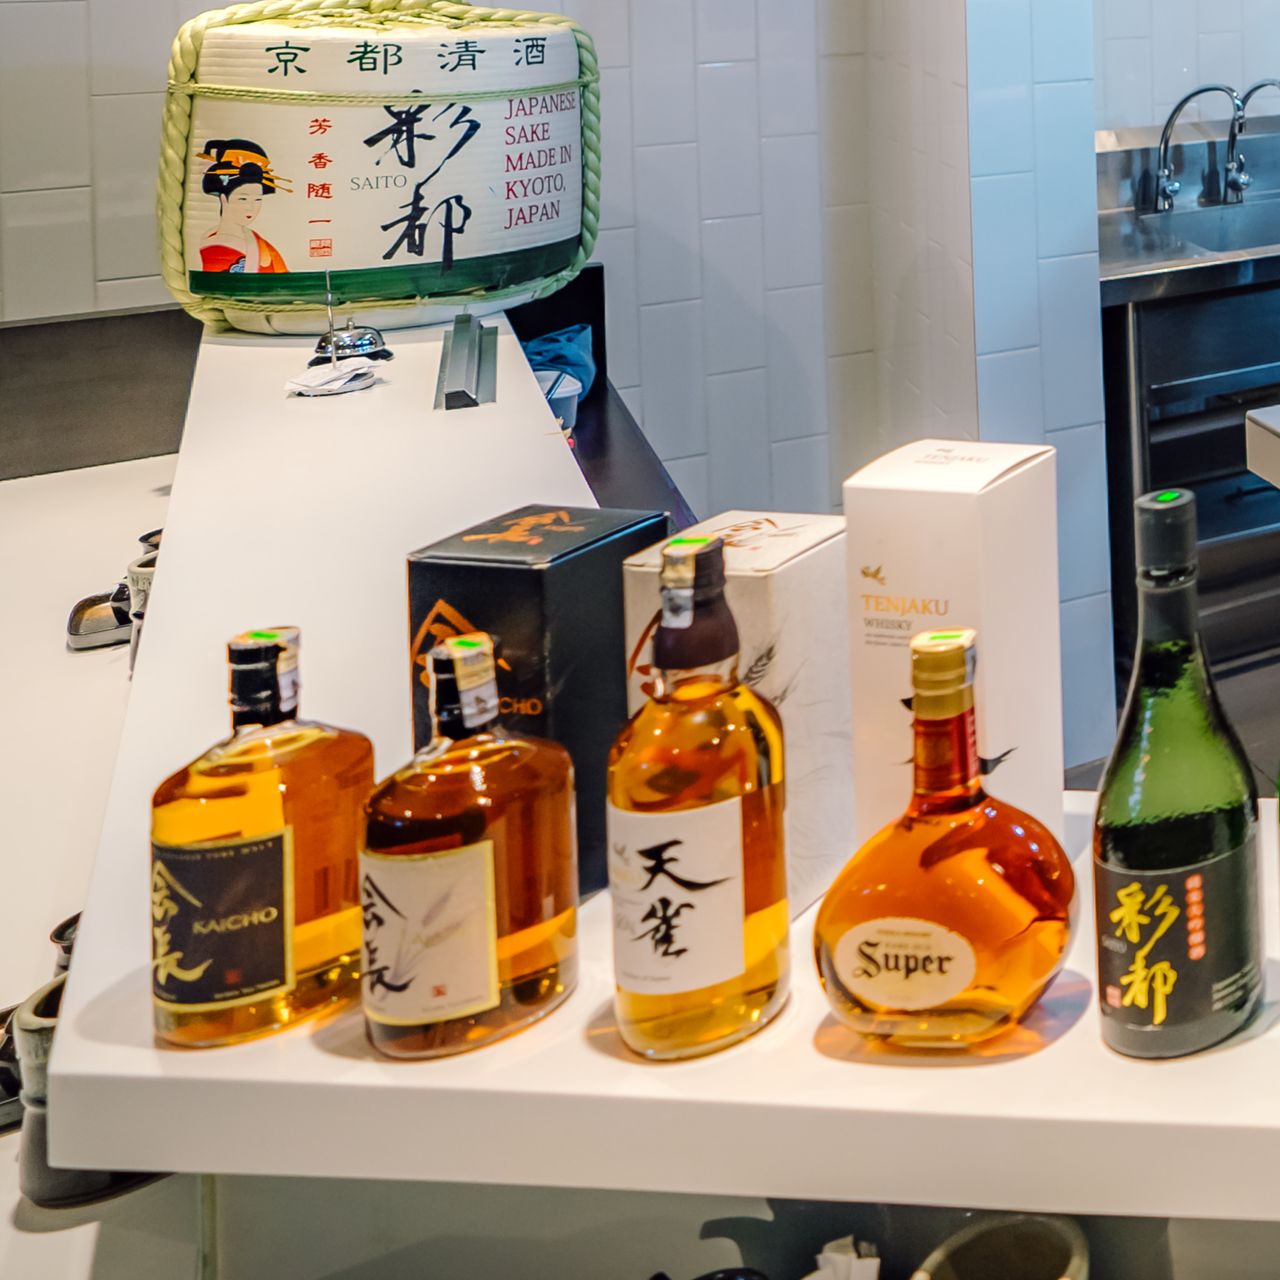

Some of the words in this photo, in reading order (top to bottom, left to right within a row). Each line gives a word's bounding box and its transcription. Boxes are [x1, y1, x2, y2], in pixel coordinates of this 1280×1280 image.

[265, 37, 547, 76] 京都清酒
[504, 91, 576, 120] JAPANESE
[505, 122, 550, 145] SAKE
[308, 118, 333, 224] 芳香随一
[505, 148, 556, 173] MADE
[560, 144, 572, 164] IN
[350, 175, 407, 191] SAITO
[505, 173, 566, 200] KYOTO,
[504, 200, 560, 230] JAPAN
[861, 594, 949, 617] TENJAKU
[192, 906, 279, 935] KAICHO
[852, 941, 954, 979] Super
